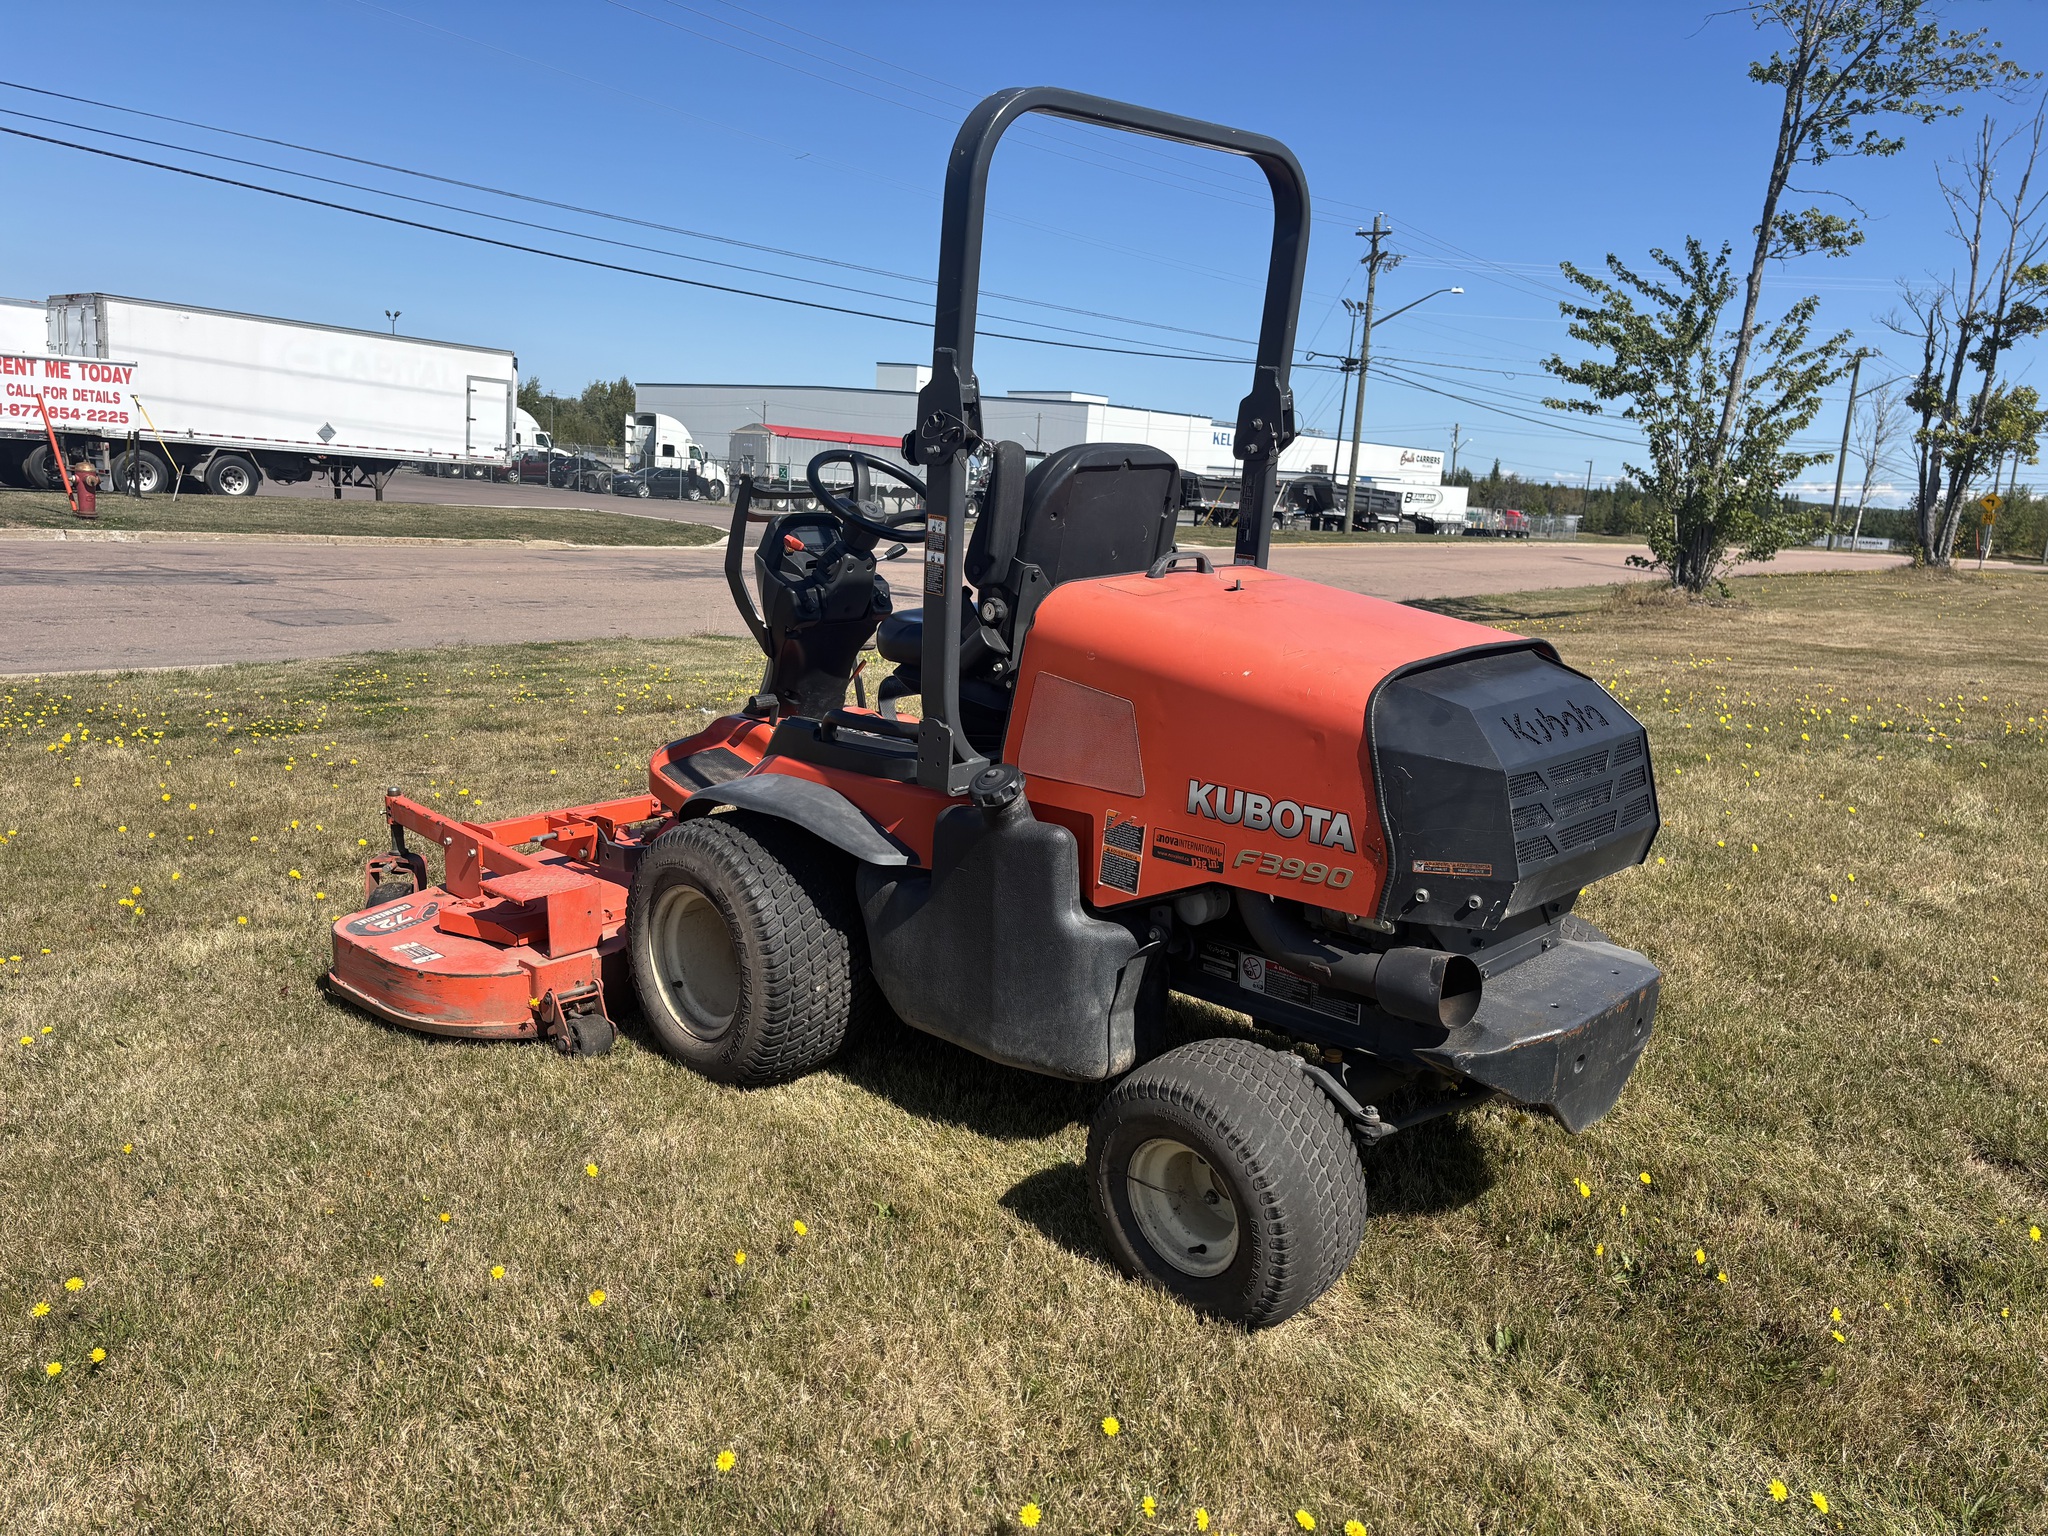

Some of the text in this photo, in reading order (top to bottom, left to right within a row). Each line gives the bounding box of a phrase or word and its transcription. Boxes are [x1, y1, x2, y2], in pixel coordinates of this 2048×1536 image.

[0, 357, 133, 384] ENT ME TODAY
[6, 383, 121, 404] CALL FOR DETAILS
[0, 403, 129, 424] -877854-2225
[1416, 455, 1440, 464] CARRIERS
[1501, 700, 1609, 745] Kubota
[1186, 779, 1356, 853] KUBOTA
[1191, 857, 1208, 871] Dig
[1233, 849, 1354, 890] F3990
[354, 903, 412, 926] COMMERCIAL
[373, 913, 414, 929] 72
[716, 887, 754, 1066] TURF MASTER
